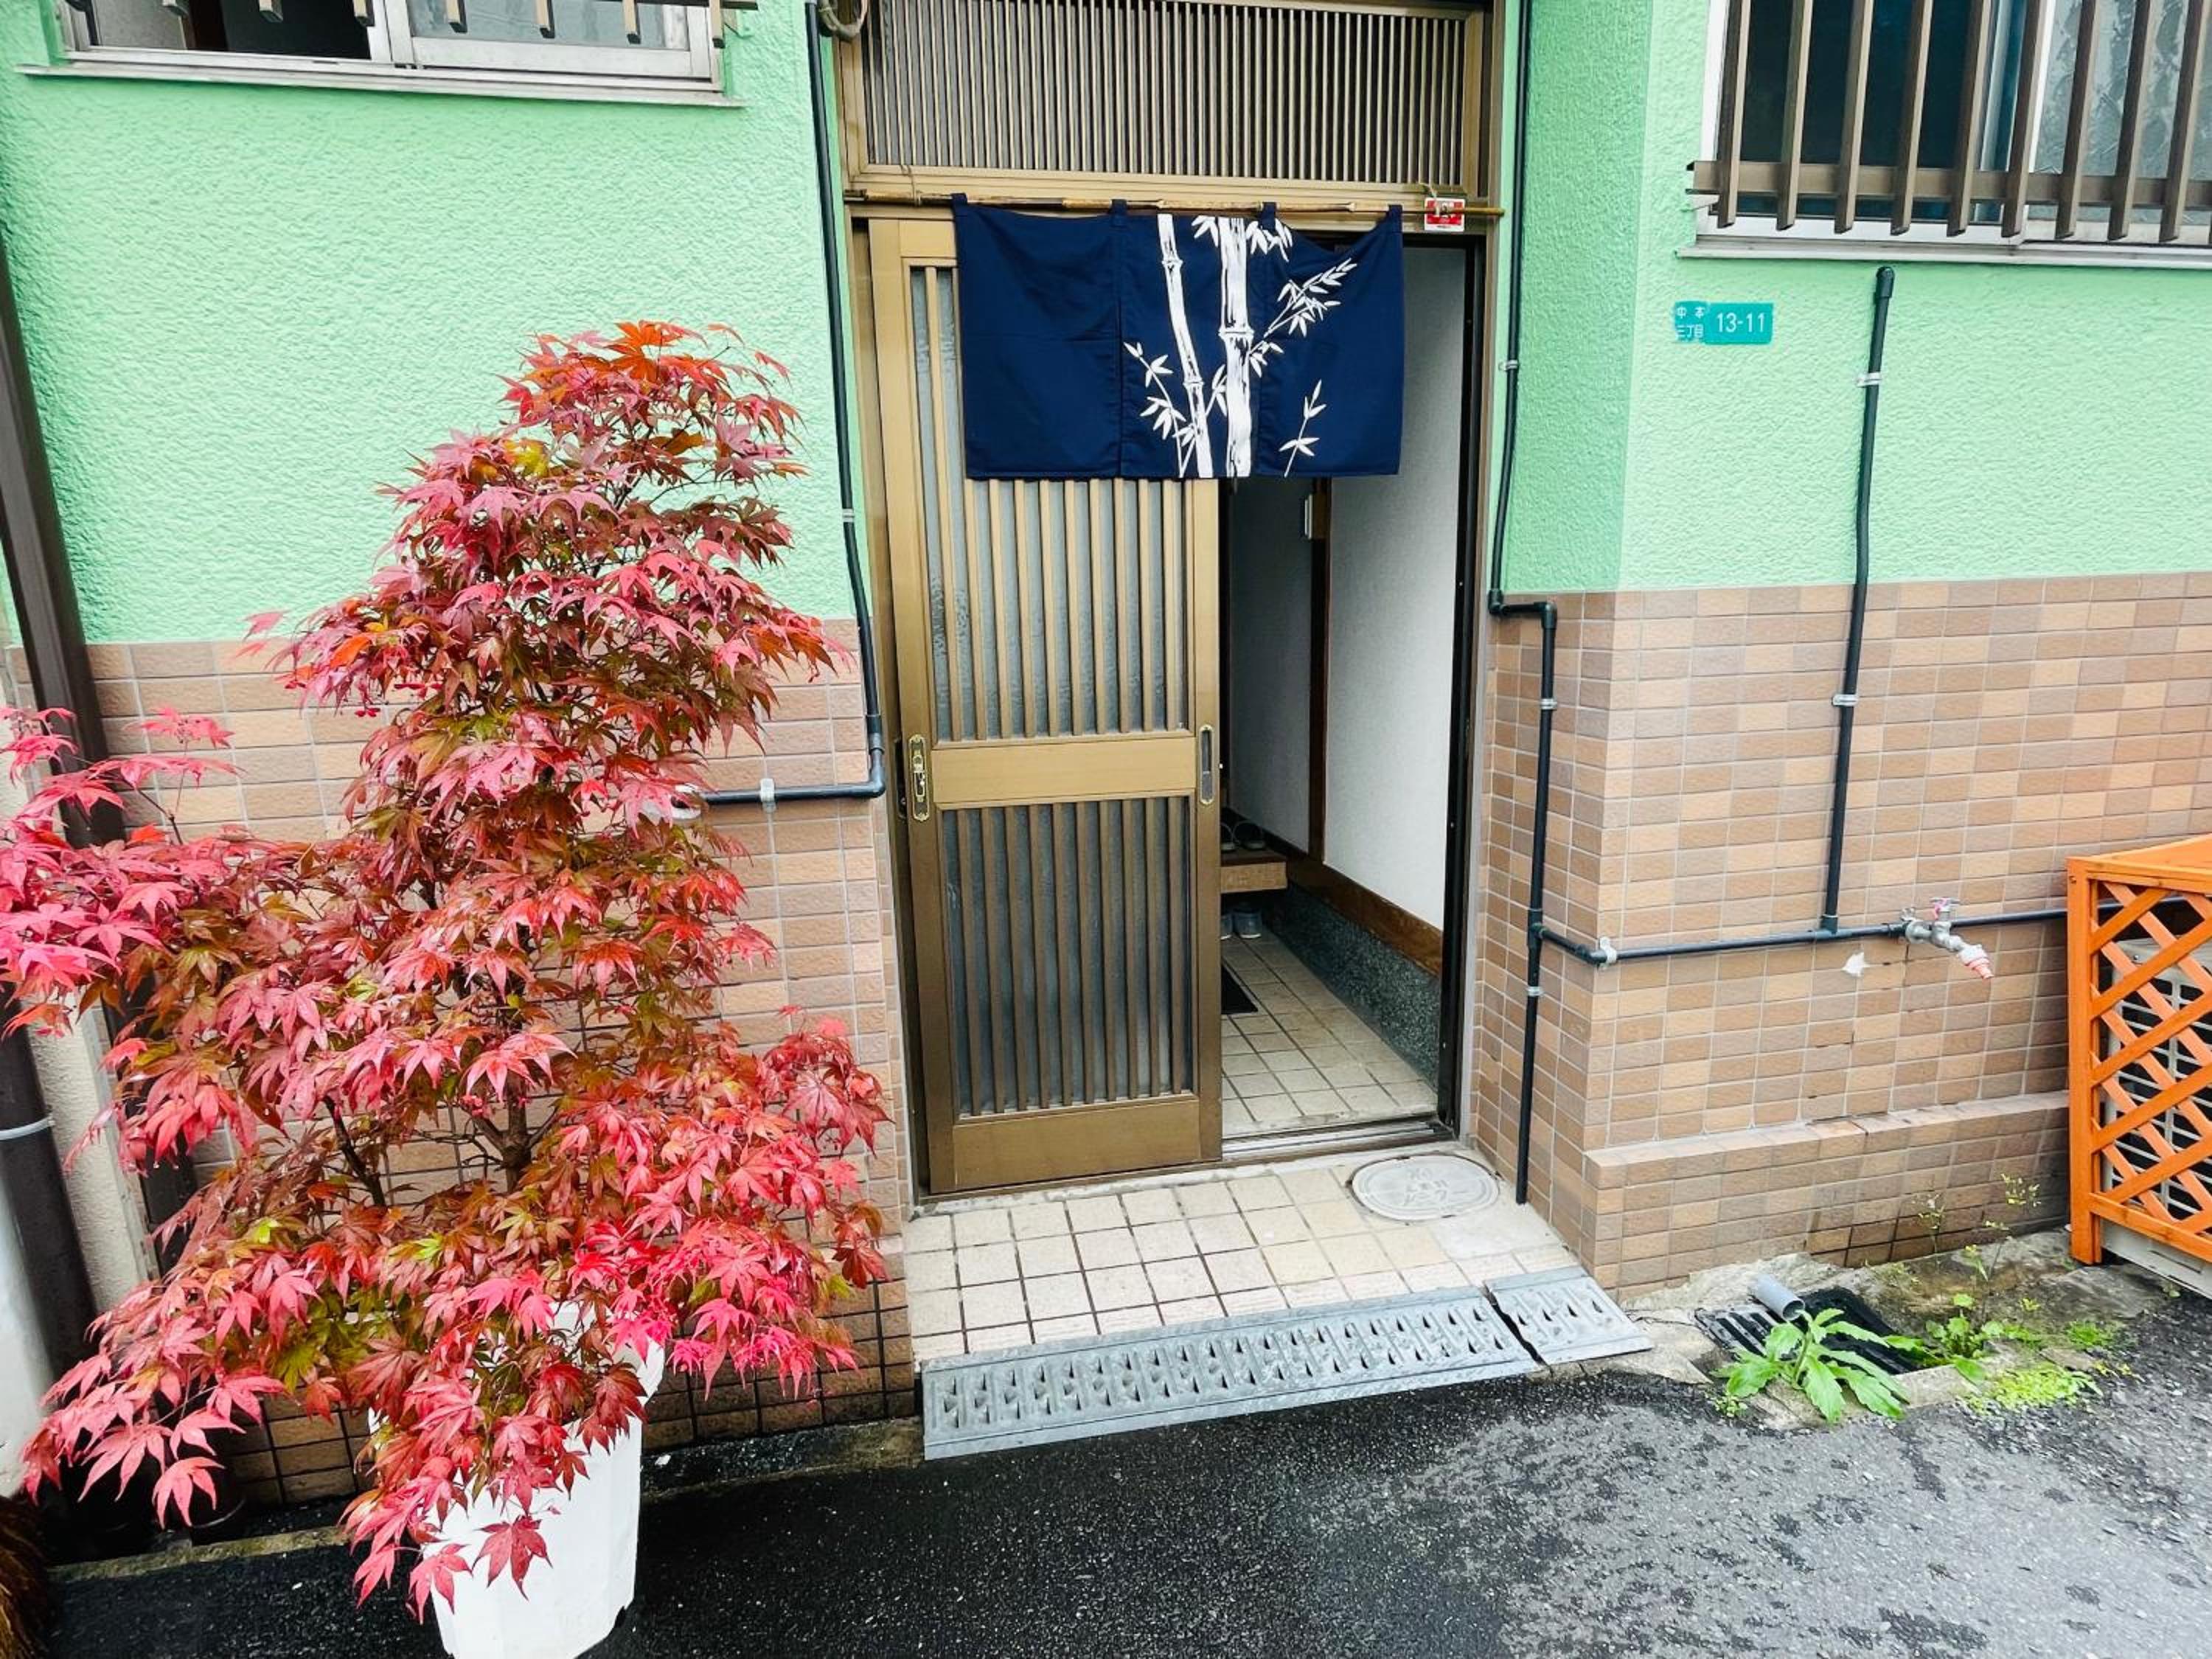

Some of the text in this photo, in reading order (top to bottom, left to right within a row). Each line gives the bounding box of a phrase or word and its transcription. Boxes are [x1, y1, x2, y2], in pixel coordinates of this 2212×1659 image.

[1676, 324, 1704, 338] 三丁目
[1717, 312, 1765, 333] 13-11
